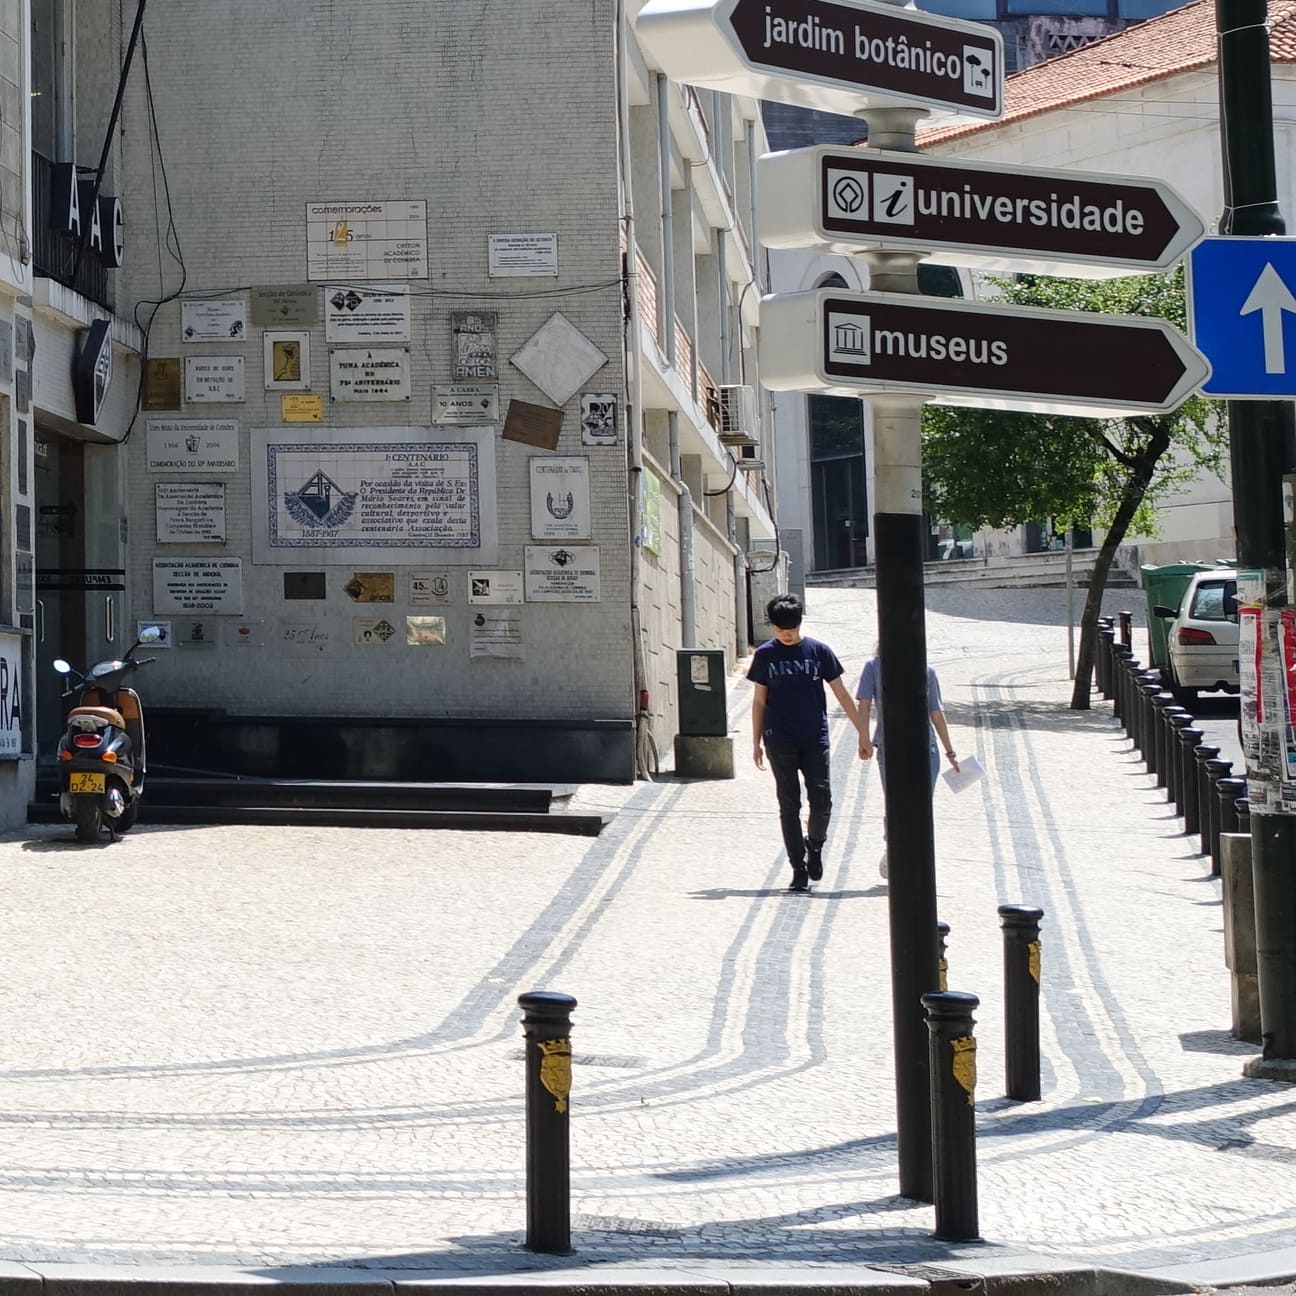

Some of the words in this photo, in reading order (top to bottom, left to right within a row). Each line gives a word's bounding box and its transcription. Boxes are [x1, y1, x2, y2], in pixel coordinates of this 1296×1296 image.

[763, 6, 845, 55] jardim
[854, 25, 961, 80] botânico
[312, 205, 383, 215] comemorações
[917, 184, 1145, 236] universidade
[874, 328, 1009, 366] museus
